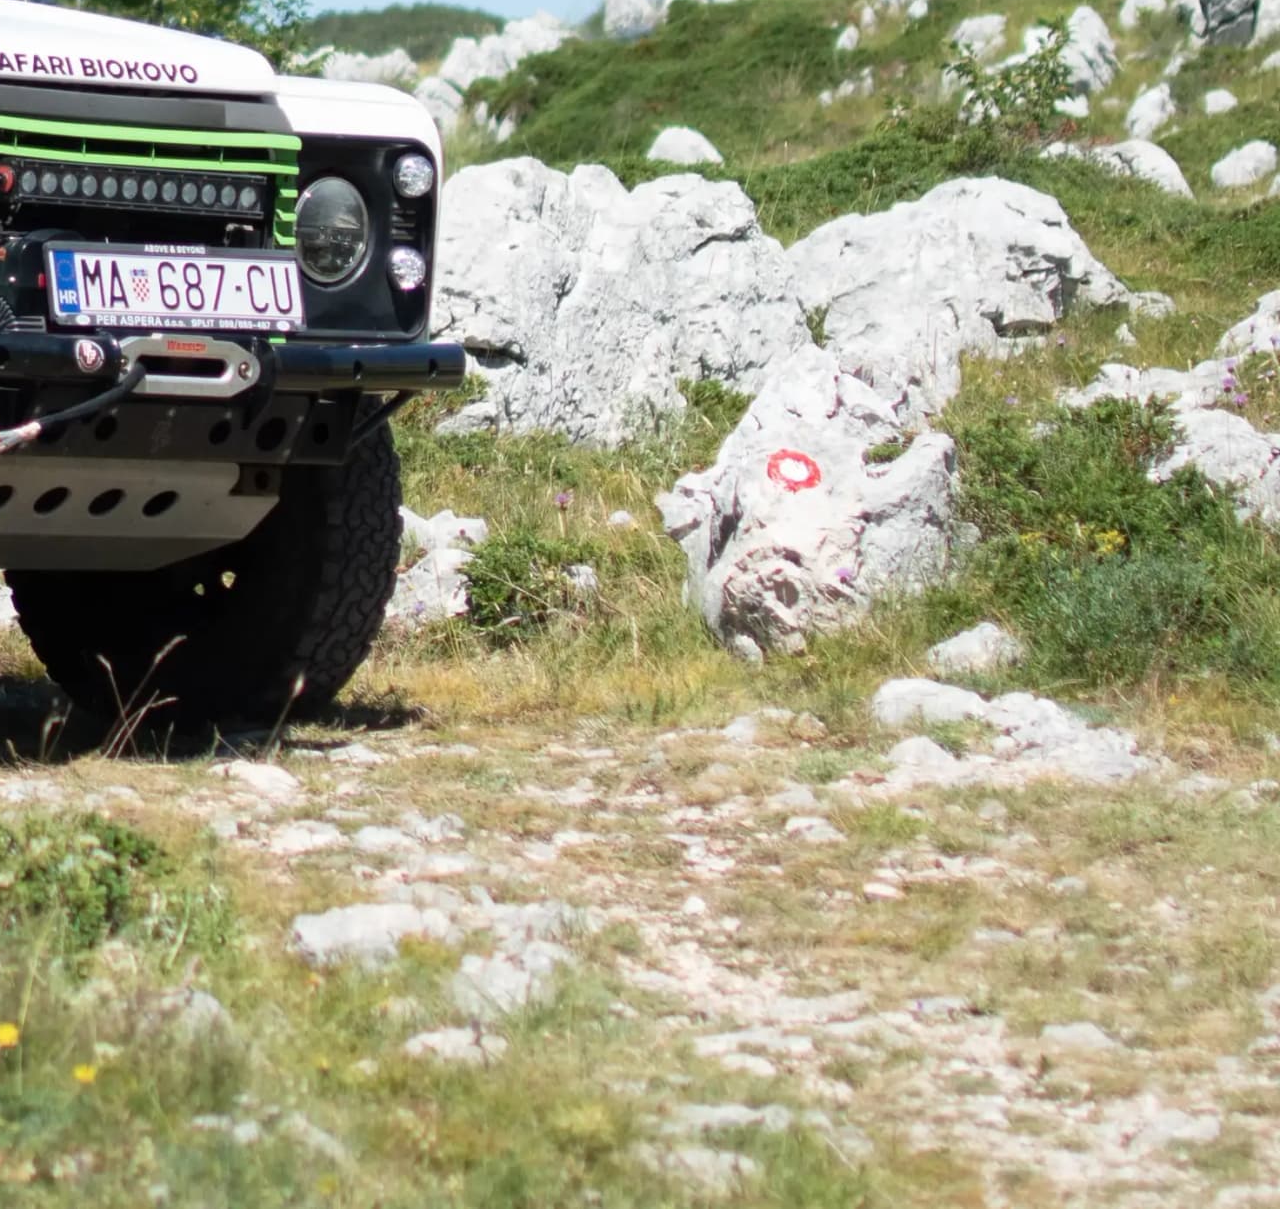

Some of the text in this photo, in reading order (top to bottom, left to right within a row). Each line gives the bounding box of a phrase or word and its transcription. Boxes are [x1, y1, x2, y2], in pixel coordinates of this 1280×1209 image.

[80, 57, 198, 83] BIOKOVO
[80, 259, 130, 309] MA
[59, 290, 78, 305] HR
[96, 314, 118, 326] PER
[120, 315, 163, 327] ASPERA
